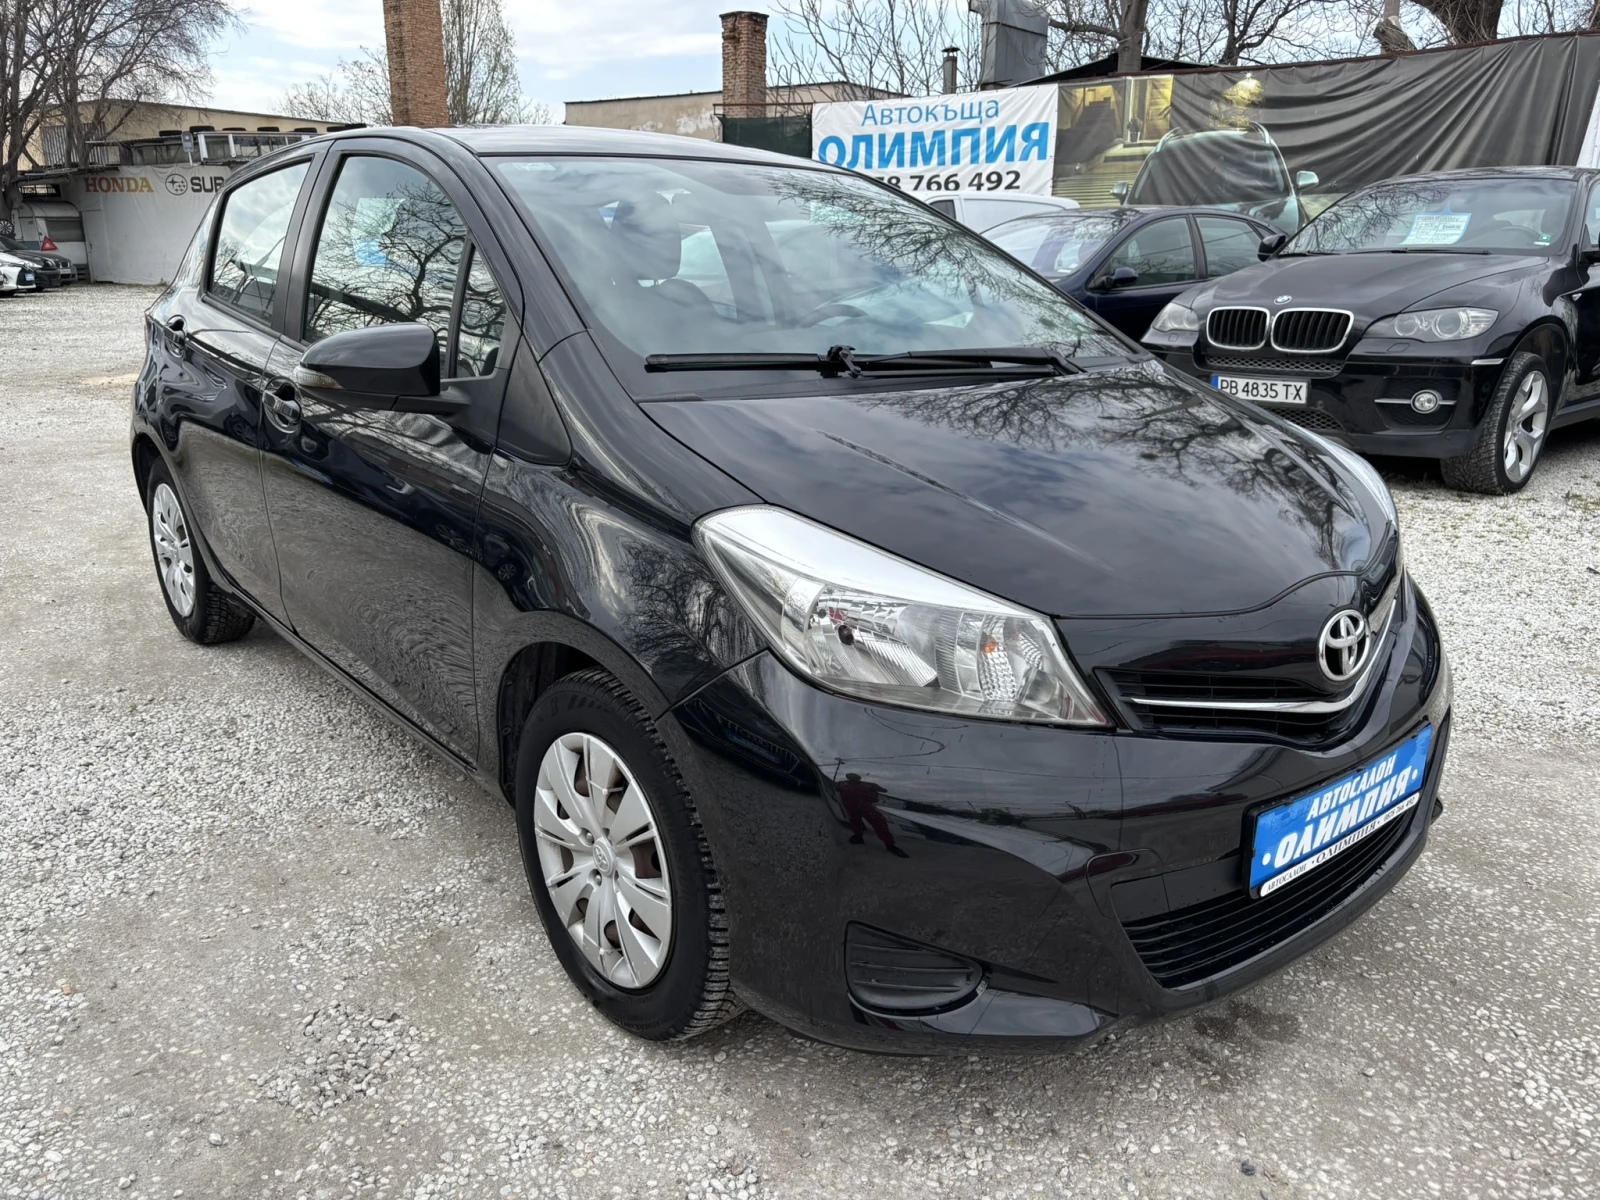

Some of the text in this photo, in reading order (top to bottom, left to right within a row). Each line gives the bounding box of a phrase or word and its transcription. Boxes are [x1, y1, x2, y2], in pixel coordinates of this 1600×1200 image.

[861, 99, 1000, 127] Автокъща
[818, 121, 1050, 170] ОЛИМПИЯ
[84, 175, 155, 193] HONDA
[909, 173, 960, 191] 766
[967, 170, 1021, 191] 492
[1242, 381, 1278, 398] 4835
[1305, 753, 1397, 822] АВТОСАЛОН
[1273, 765, 1413, 869] ОЛИМПИЯ
